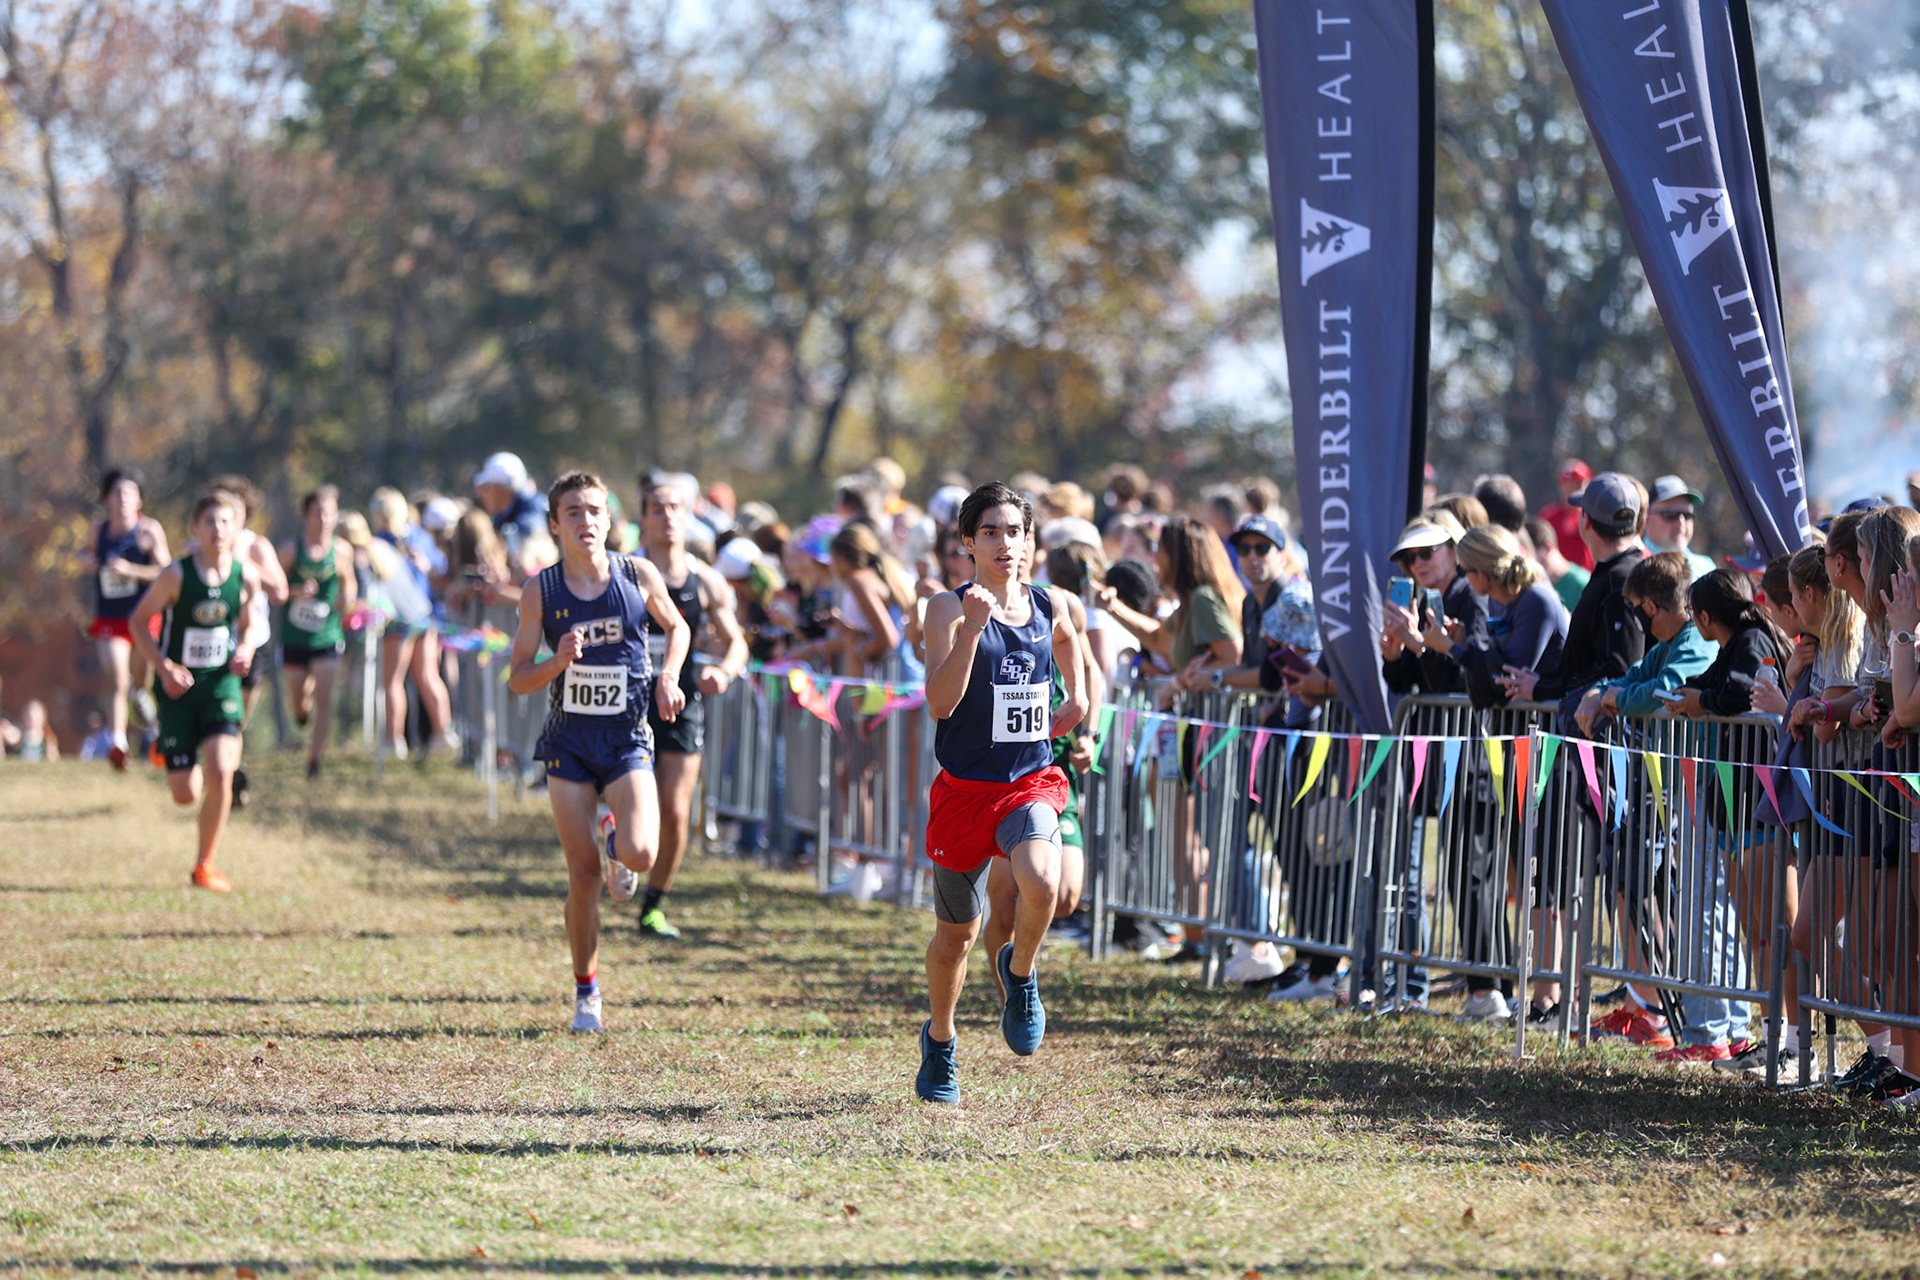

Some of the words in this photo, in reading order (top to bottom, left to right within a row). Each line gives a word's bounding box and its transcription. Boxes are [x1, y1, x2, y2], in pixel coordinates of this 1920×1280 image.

[1317, 9, 1352, 181] HEALT
[1319, 299, 1353, 643] VANDERBILT
[569, 683, 621, 707] 1052
[1002, 692, 1024, 700] TSSAA
[1007, 705, 1043, 734] 519
